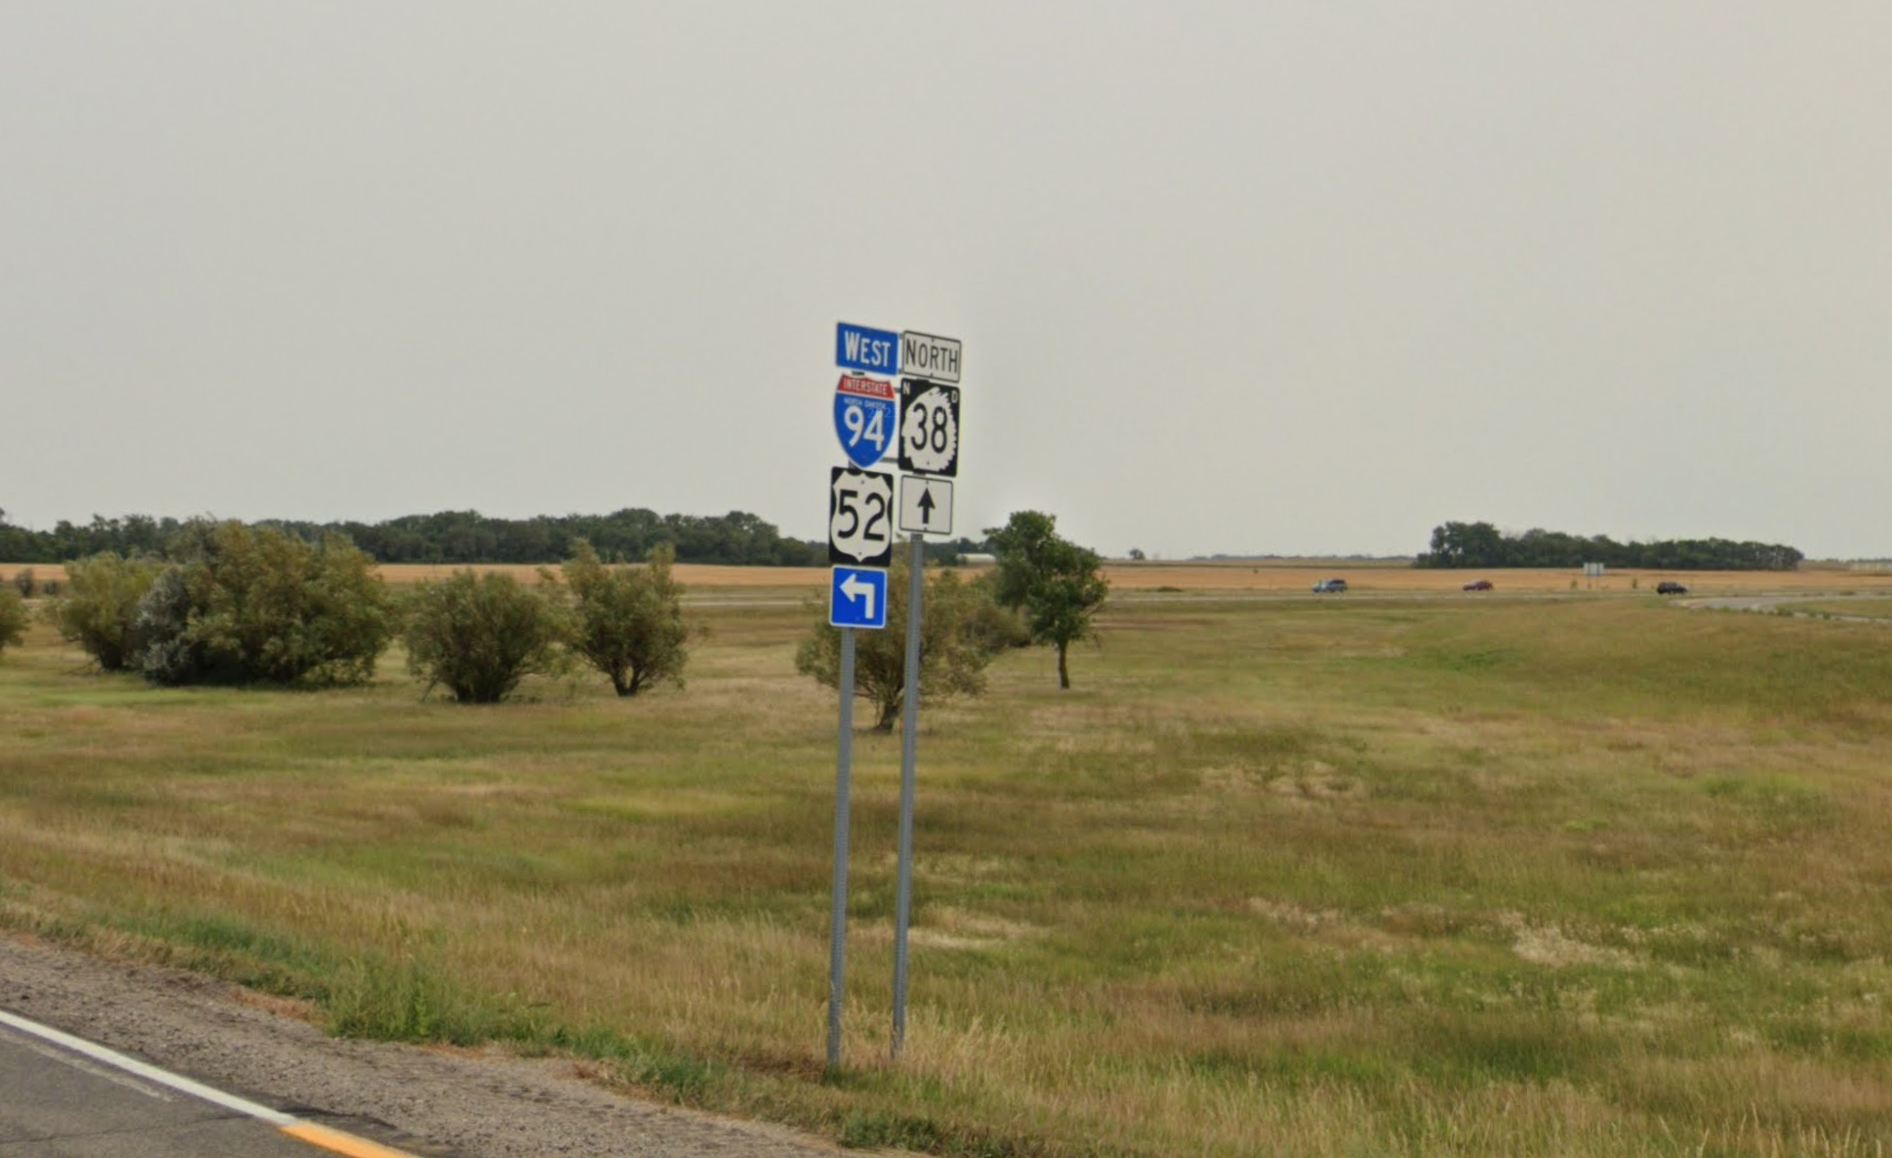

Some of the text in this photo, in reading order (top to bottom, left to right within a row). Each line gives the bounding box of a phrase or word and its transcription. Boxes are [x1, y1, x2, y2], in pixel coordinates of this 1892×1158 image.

[844, 330, 892, 367] WEST
[905, 338, 959, 374] NORTH
[843, 378, 888, 396] INTERSTATE
[903, 381, 959, 404] N D
[844, 405, 885, 452] 94
[911, 402, 948, 454] 38
[837, 488, 886, 542] 52
